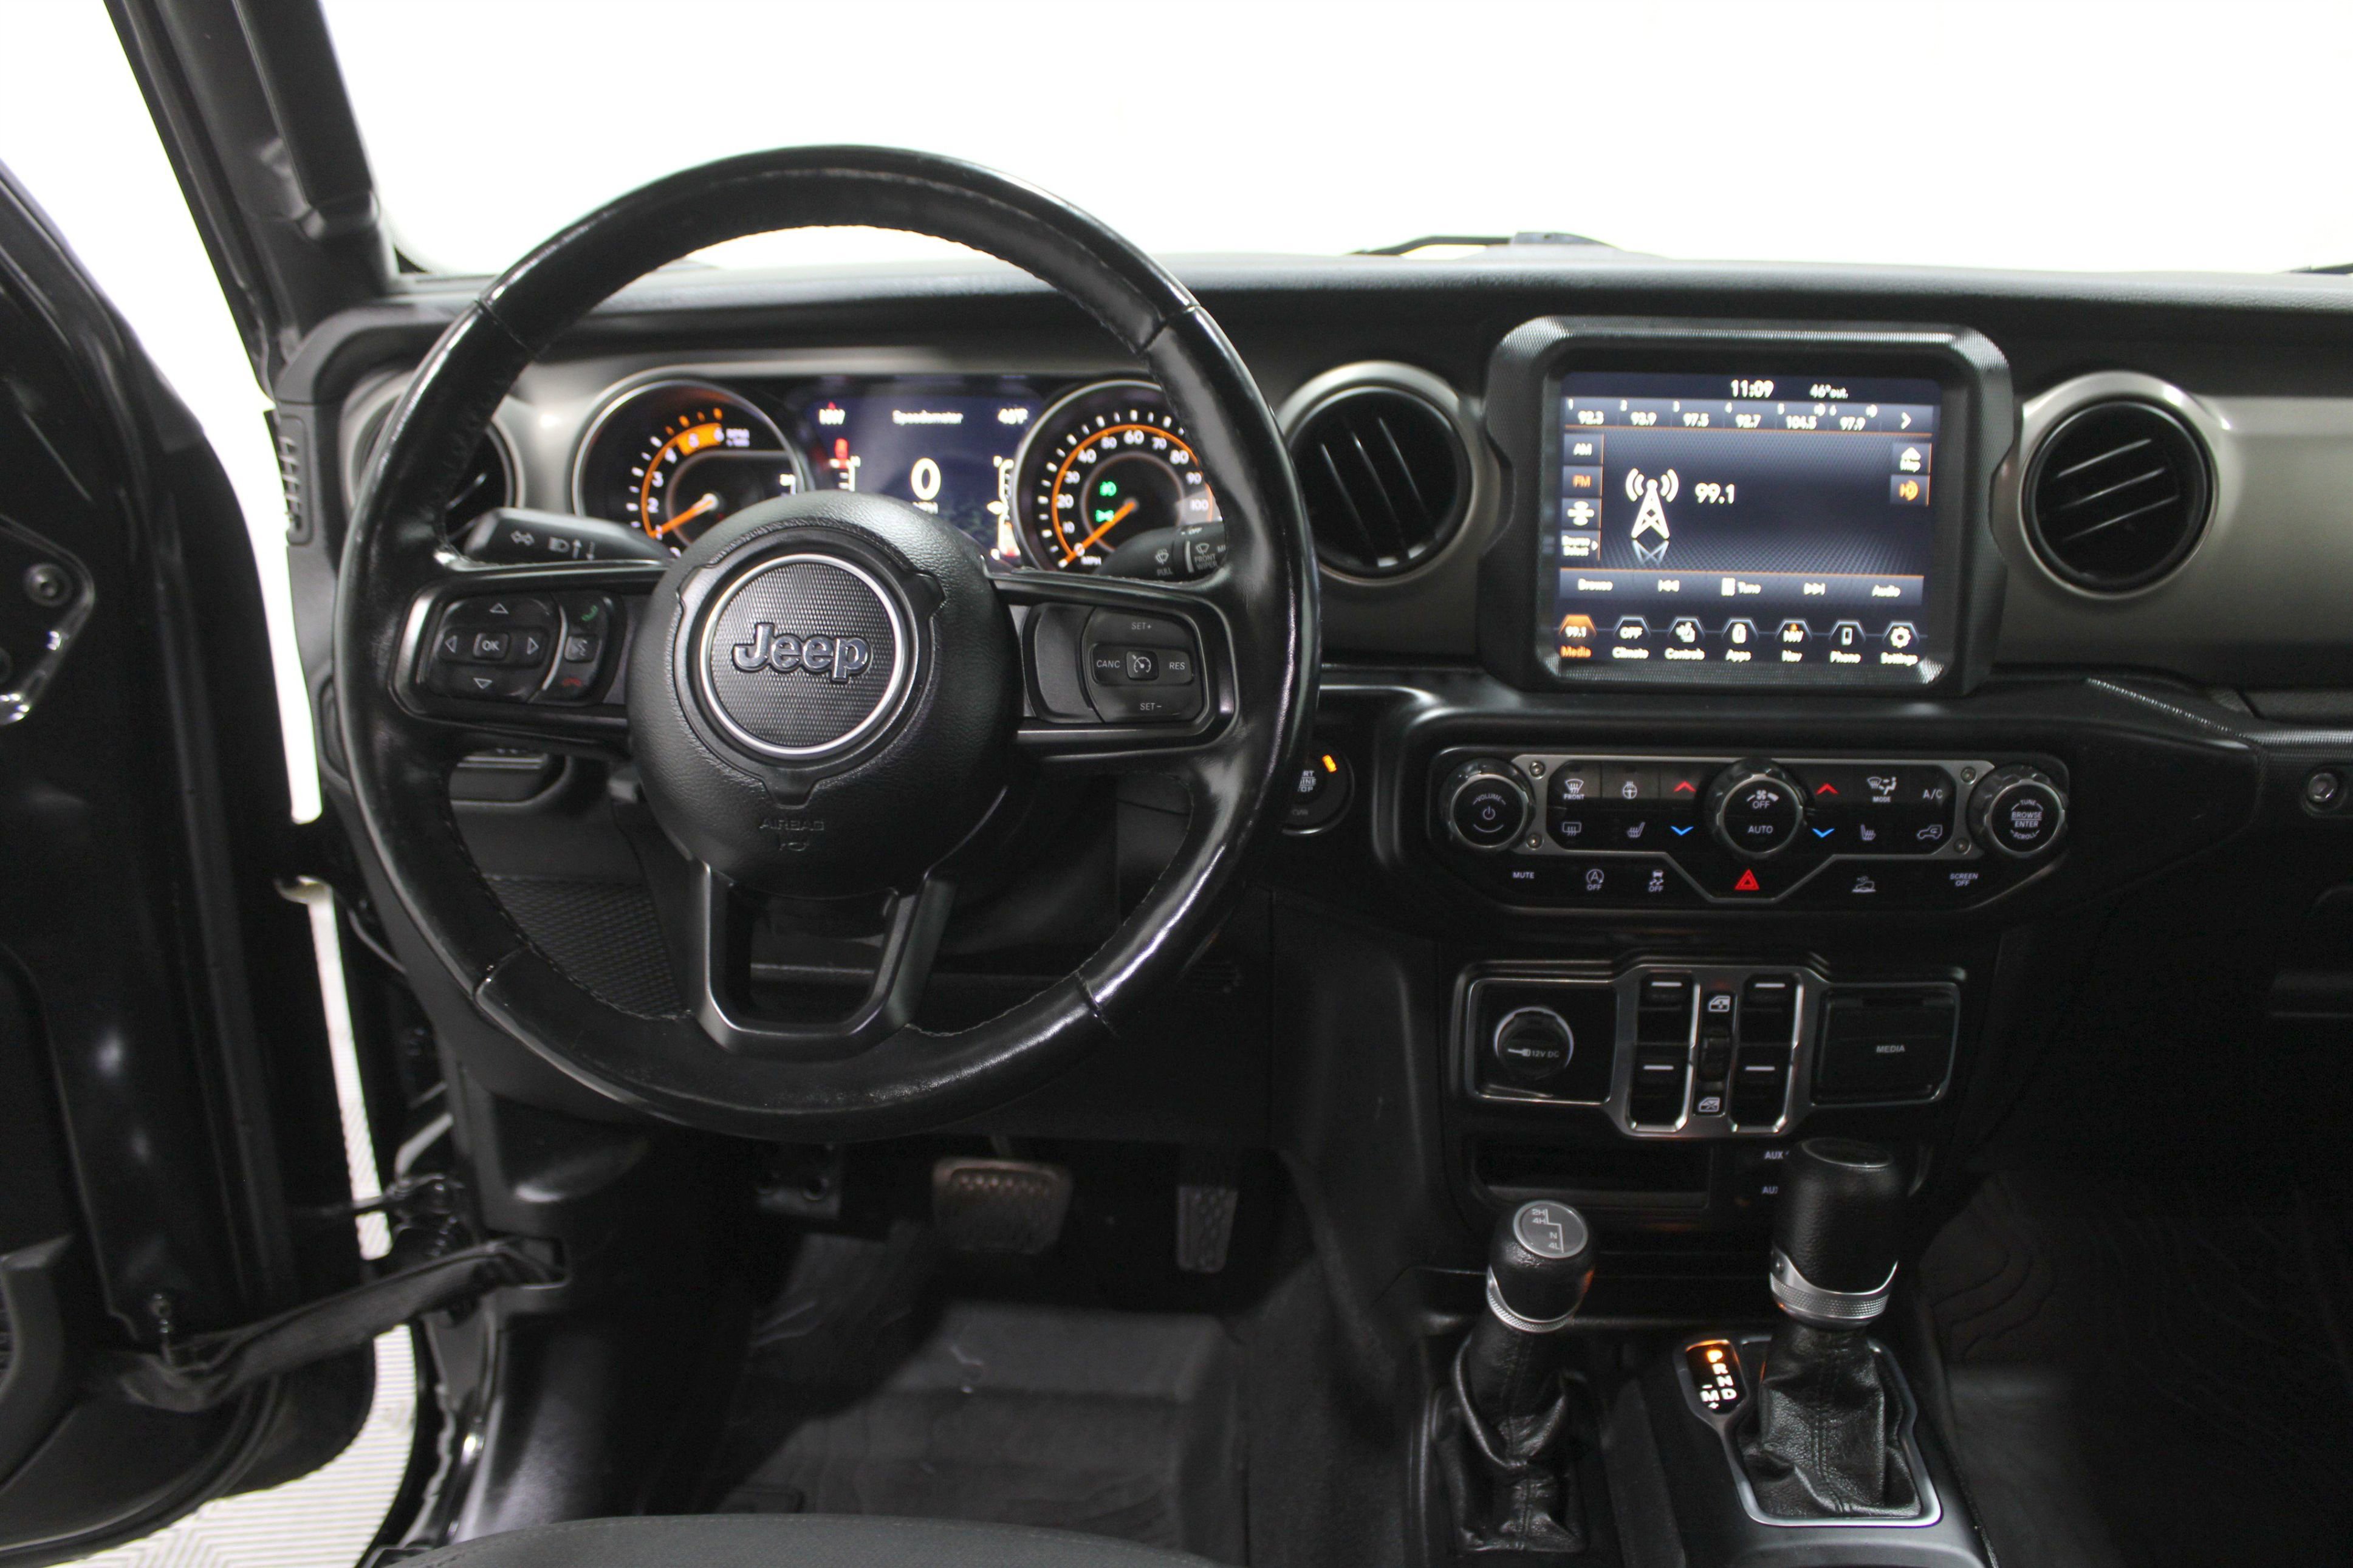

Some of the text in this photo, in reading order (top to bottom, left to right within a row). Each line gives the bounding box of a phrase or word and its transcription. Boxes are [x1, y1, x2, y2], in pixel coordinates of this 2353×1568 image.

[1731, 379, 1774, 398] 11:09
[1631, 411, 1657, 426] 93.9
[1683, 413, 1710, 428] 97.5
[1736, 414, 1761, 428] 92.7
[1840, 417, 1866, 431] 97.9
[1101, 436, 1117, 449] 50
[1124, 430, 1143, 444] 60
[1152, 437, 1167, 450] 70
[1078, 448, 1097, 464] 40
[1573, 443, 1593, 456] AM
[1170, 450, 1189, 465] 80
[651, 471, 664, 487] 3
[911, 457, 941, 501] 0
[1064, 471, 1080, 484] 30
[1186, 471, 1202, 484] 90
[1572, 474, 1592, 488] FM
[1695, 482, 1735, 504] 99.1
[647, 496, 659, 513] 2
[1056, 494, 1074, 508] 20
[1190, 499, 1208, 512] 100
[1062, 521, 1075, 533] 10
[1074, 543, 1085, 556] 0
[1081, 555, 1101, 566] MPH
[1194, 553, 1215, 563] FRONT
[1738, 581, 1761, 594] Tune
[1871, 584, 1901, 597] Audio
[1565, 626, 1586, 638] 99.1
[1620, 626, 1643, 639] OFF
[1783, 630, 1804, 643] NW
[482, 640, 499, 651] OK
[1560, 646, 1592, 658] Media
[731, 622, 874, 684] Jeep
[1612, 646, 1649, 659] Climate
[1664, 647, 1705, 660] Controls
[1725, 649, 1751, 662] Apps
[1781, 649, 1803, 662] Nav
[1830, 651, 1861, 663] Phone
[1880, 651, 1918, 666] Settings
[1170, 662, 1185, 670] RES
[1476, 793, 1502, 802] VOLUME
[1923, 790, 1943, 799] A/C
[1752, 800, 1770, 809] OFF
[1747, 825, 1773, 834] AUTO
[2013, 831, 2038, 840] SCROLL
[1764, 1151, 1784, 1159] AUX
[1707, 1349, 1723, 1363] P
[1711, 1363, 1728, 1374] R
[1716, 1375, 1733, 1387] N
[1700, 1388, 1737, 1402] M D
